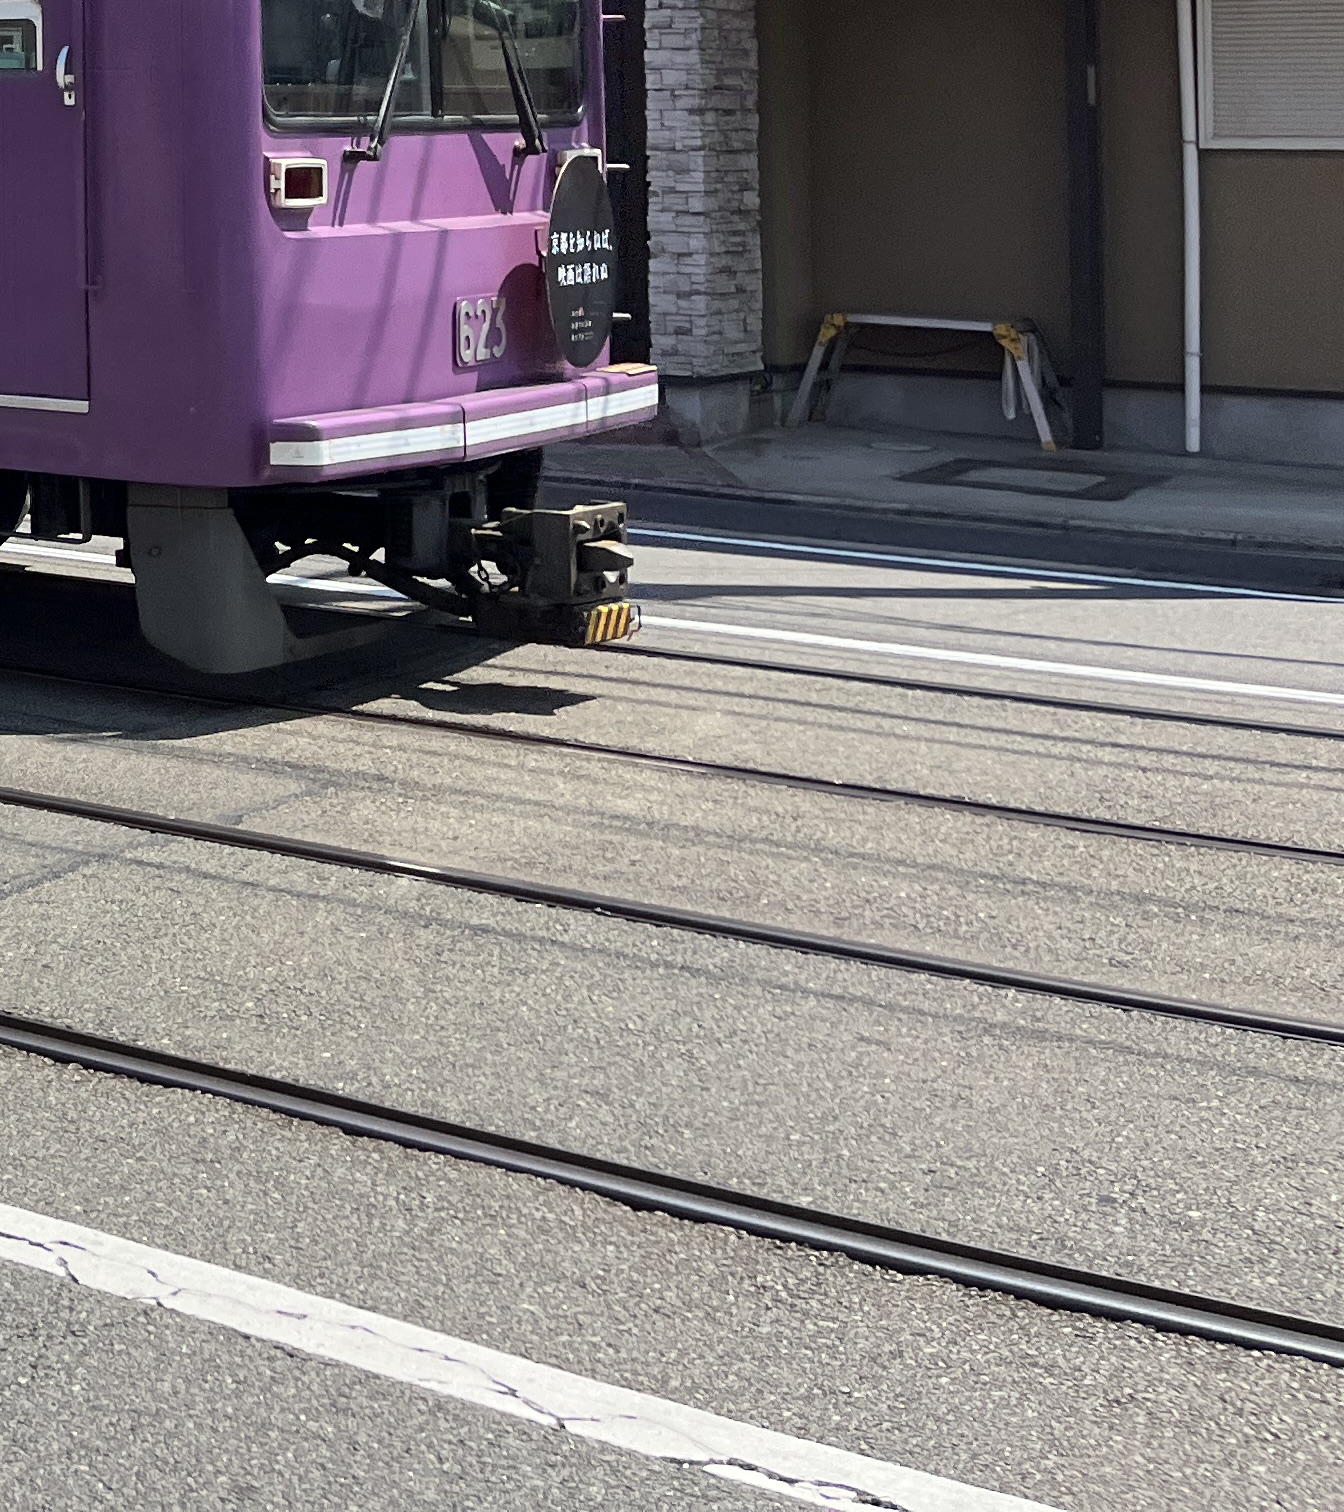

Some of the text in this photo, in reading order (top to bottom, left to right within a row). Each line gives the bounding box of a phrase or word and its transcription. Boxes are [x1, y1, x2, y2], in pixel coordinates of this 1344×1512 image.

[551, 229, 612, 255] 京都を知らねば、
[558, 263, 608, 286] 映画は語れぬ
[460, 297, 506, 363] 623
